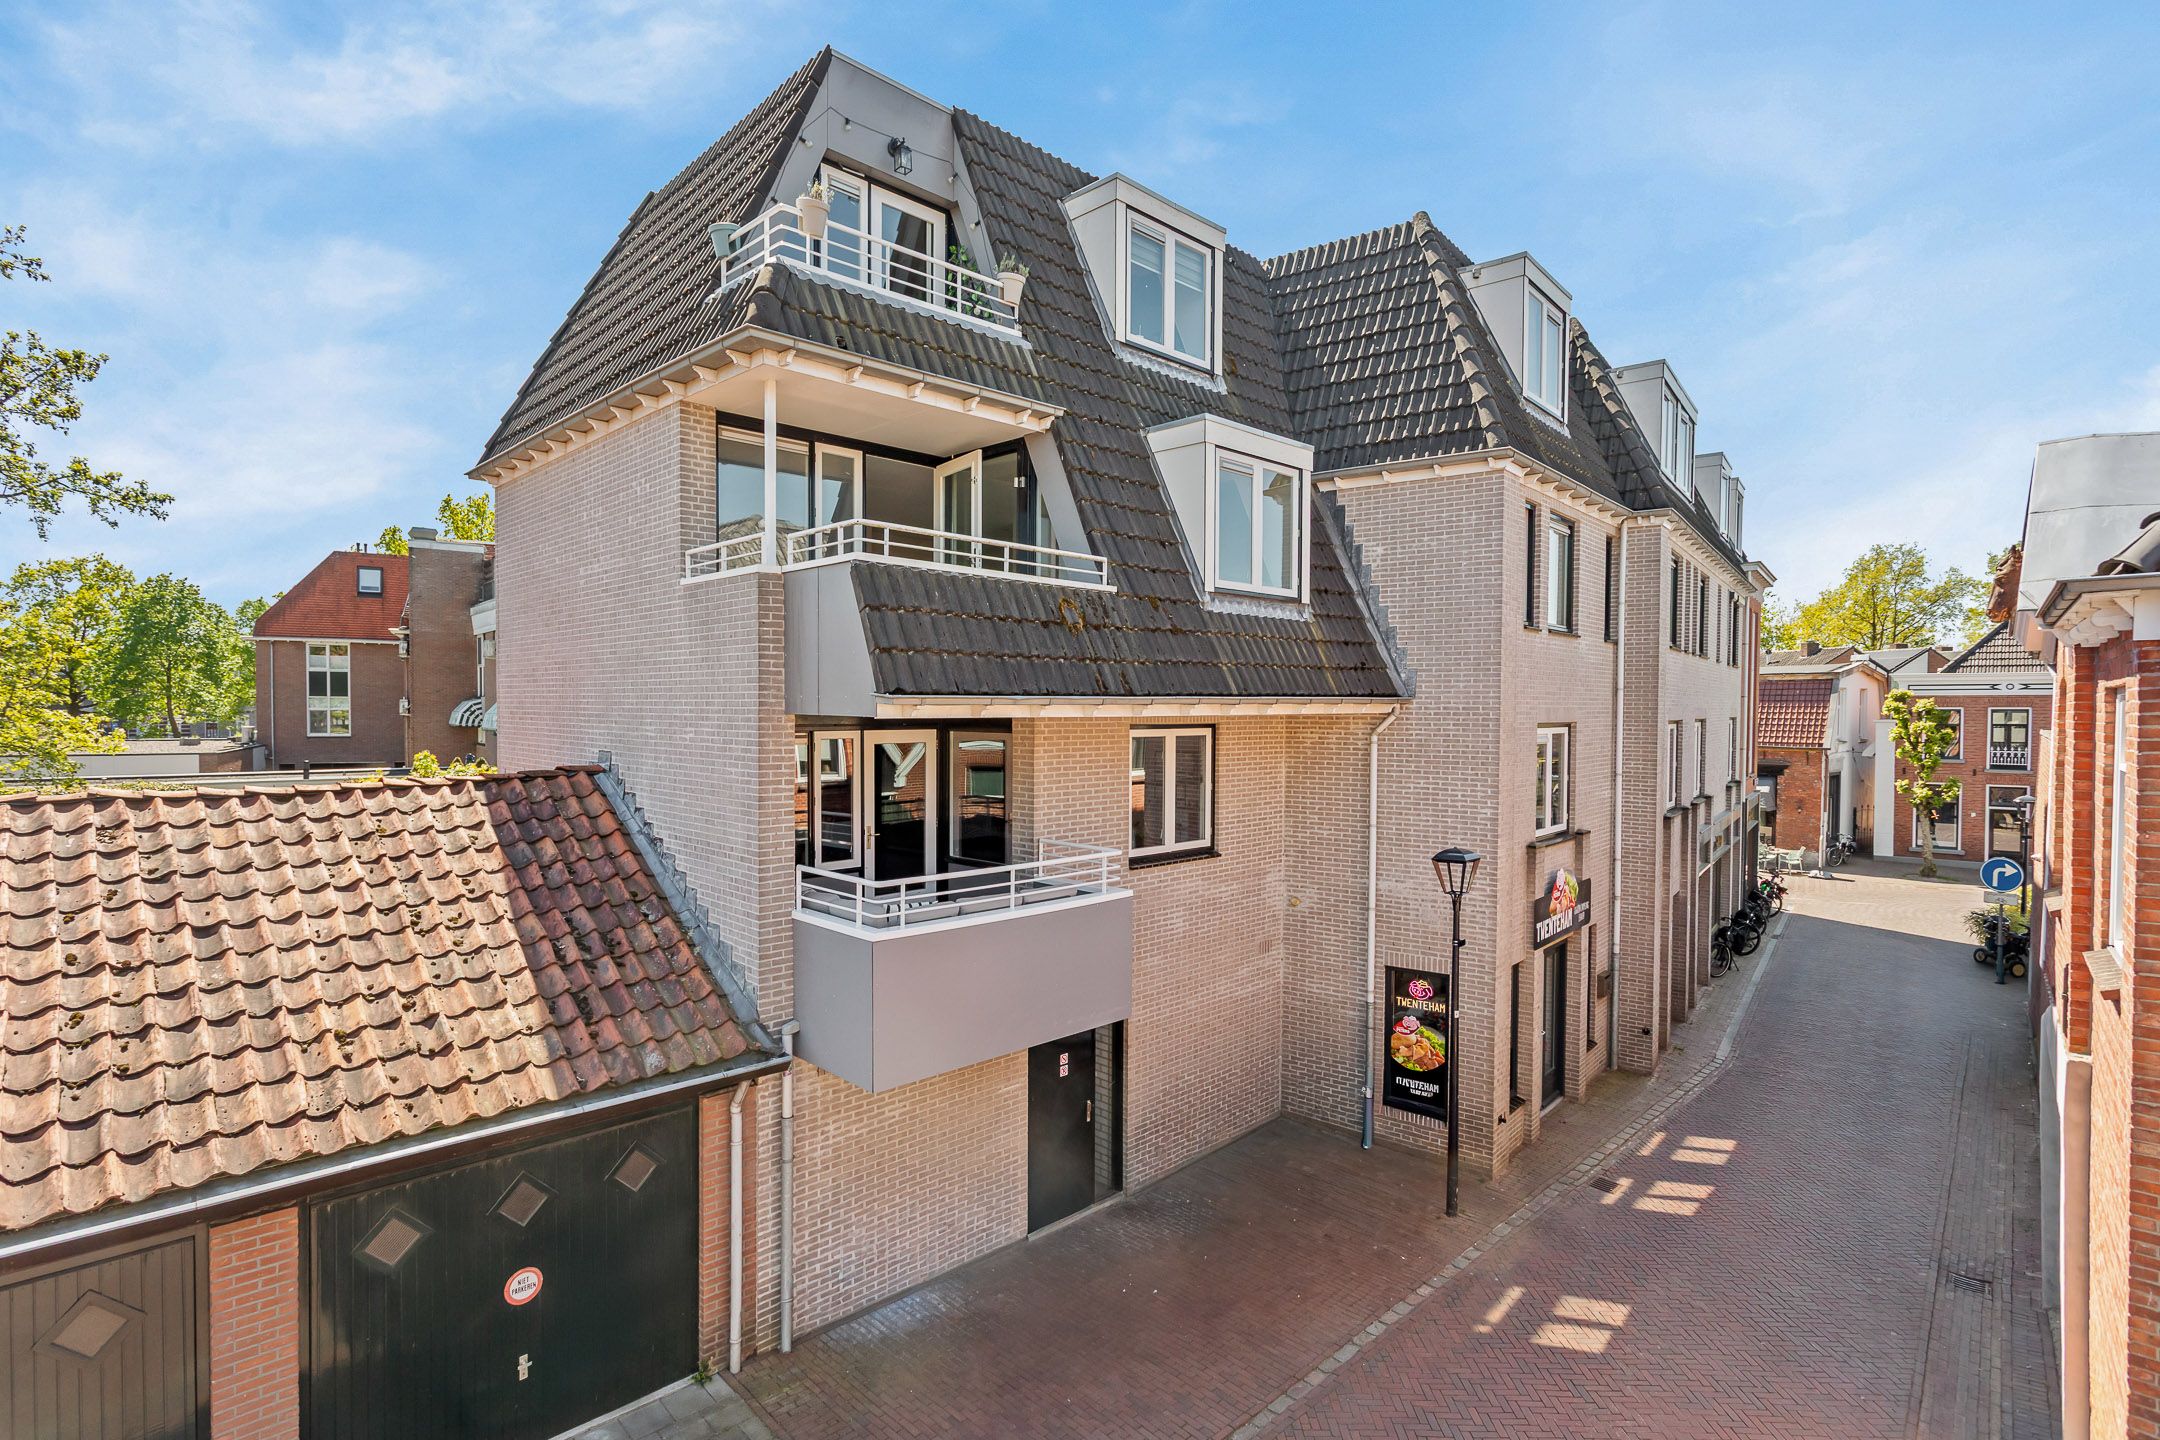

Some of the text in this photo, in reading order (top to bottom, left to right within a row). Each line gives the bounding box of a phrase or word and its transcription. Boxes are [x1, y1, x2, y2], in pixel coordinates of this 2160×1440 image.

[1536, 907, 1573, 943] TWENTEHAM
[1396, 996, 1446, 1014] TWENTEHAM
[1395, 1076, 1440, 1094] TEHAM
[511, 1282, 537, 1296] PARKEREN
[517, 1276, 530, 1286] NIET
